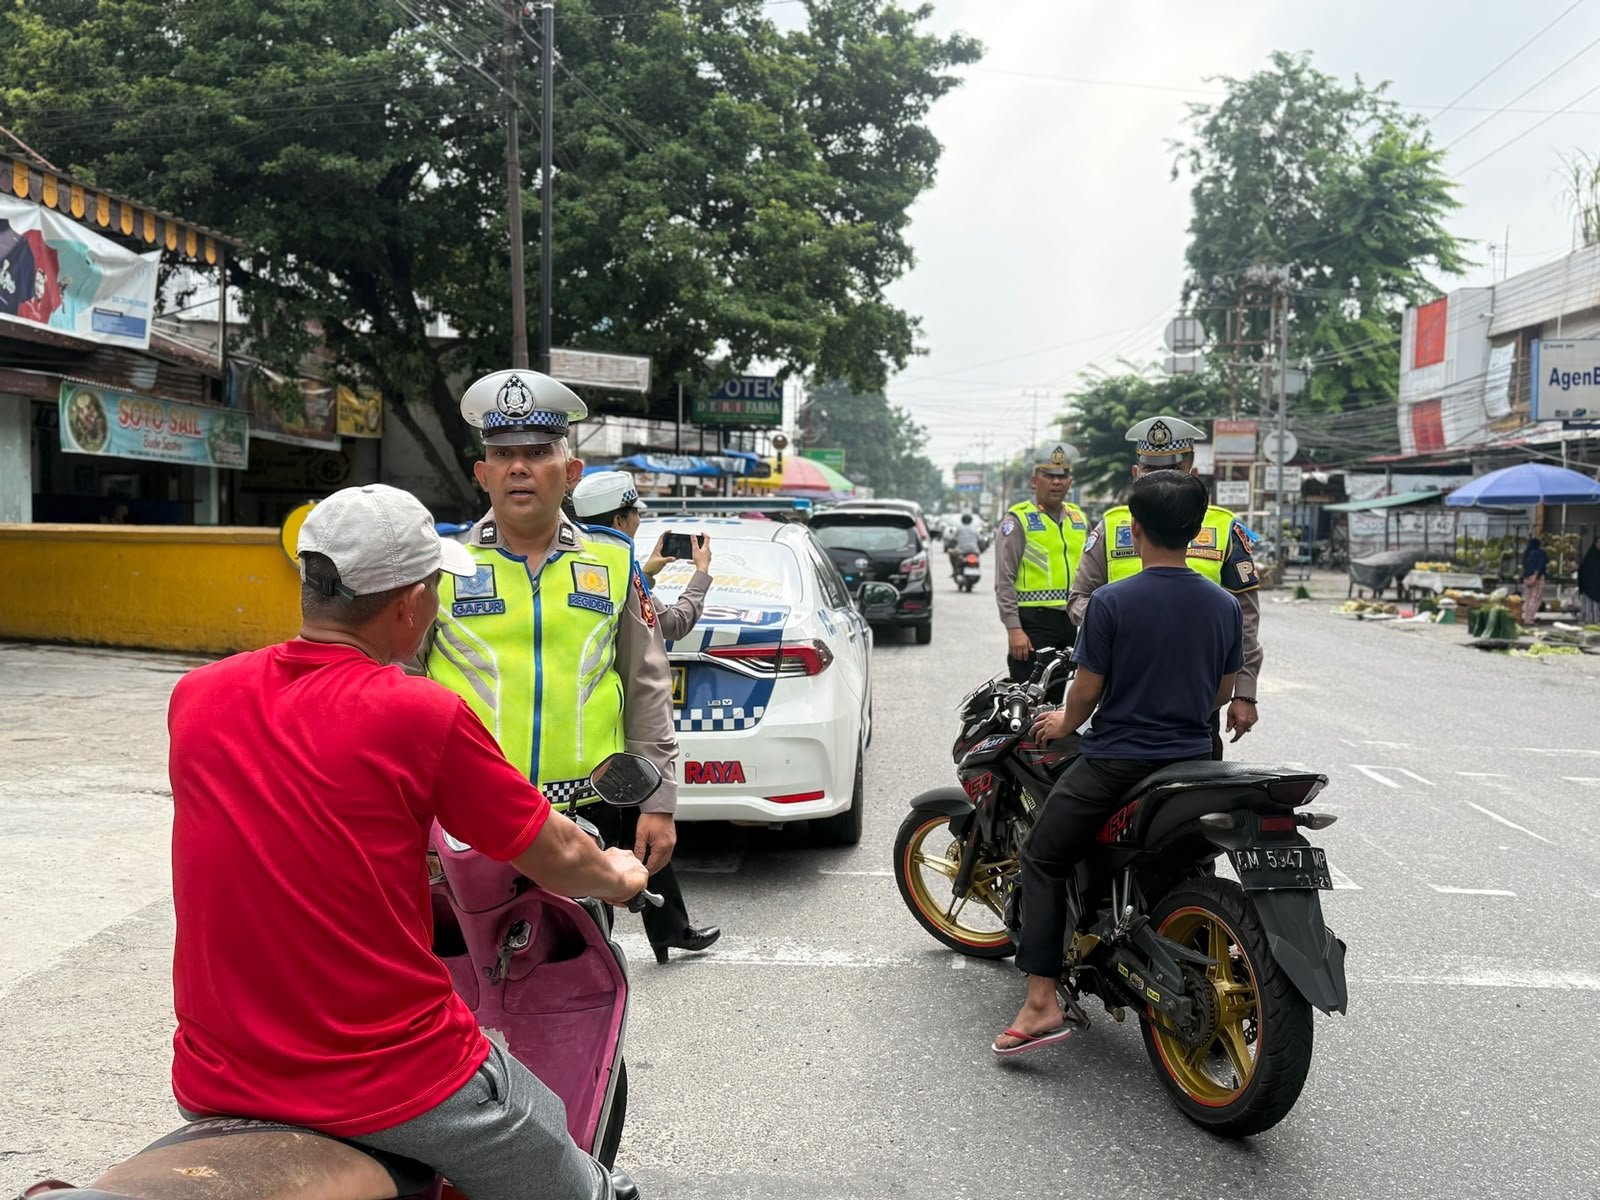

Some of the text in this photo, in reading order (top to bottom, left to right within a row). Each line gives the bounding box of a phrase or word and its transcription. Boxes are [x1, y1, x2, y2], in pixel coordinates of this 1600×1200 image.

[118, 398, 204, 439] SOTO SAIL
[716, 586, 783, 600] MELAYANI
[453, 601, 502, 616] GAFUR
[570, 594, 613, 614] REGIDENT
[685, 761, 746, 784] RAYA
